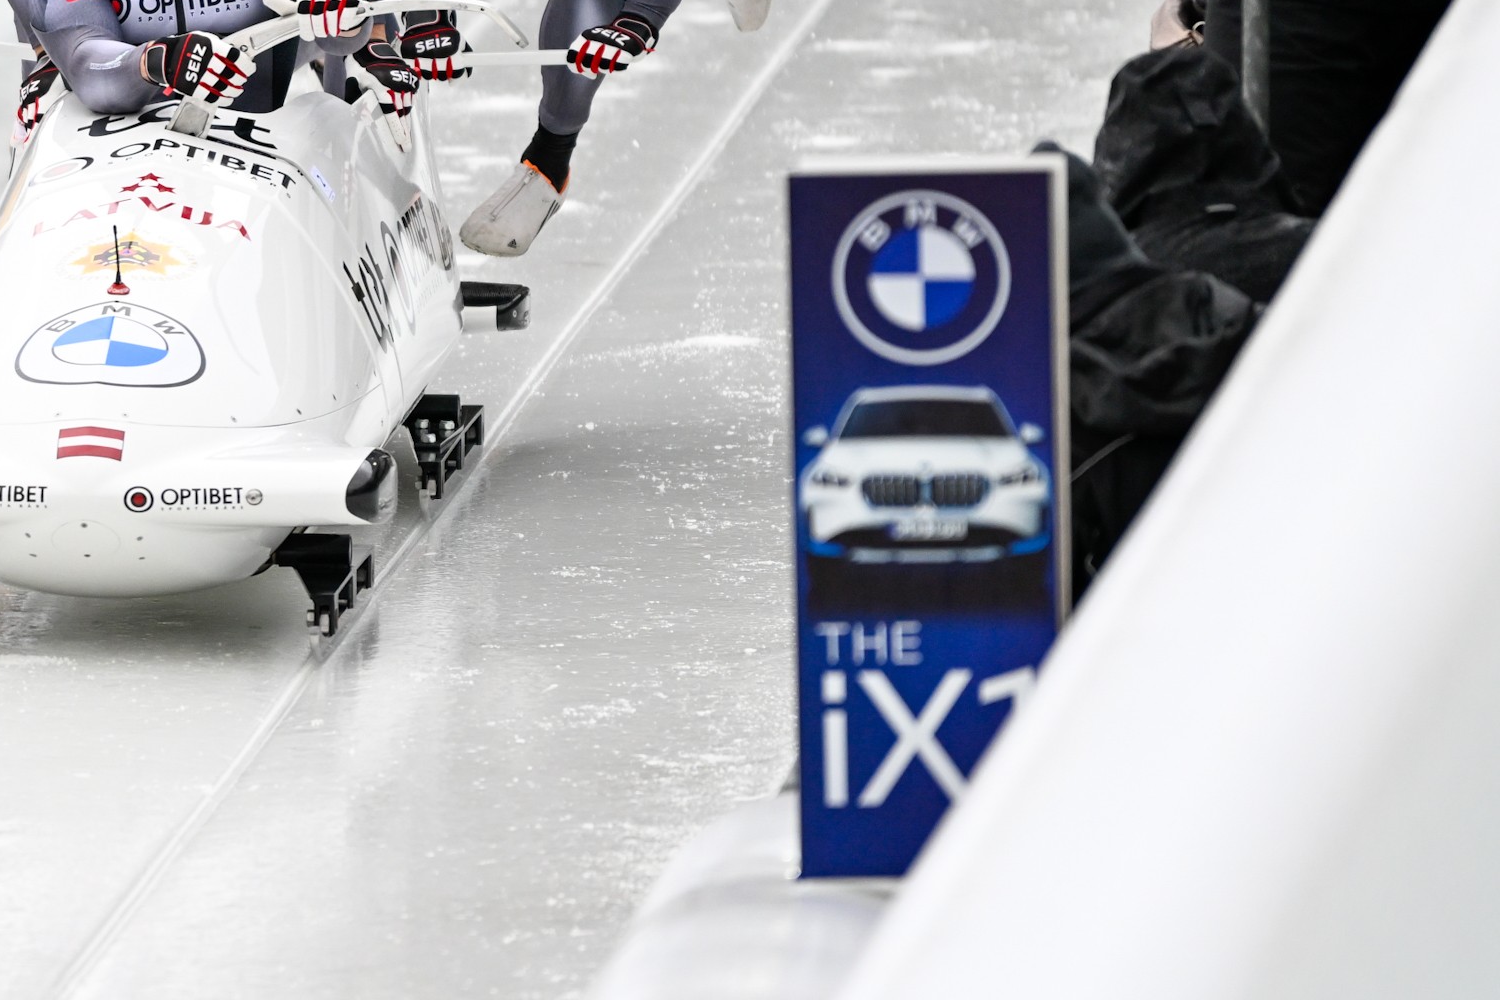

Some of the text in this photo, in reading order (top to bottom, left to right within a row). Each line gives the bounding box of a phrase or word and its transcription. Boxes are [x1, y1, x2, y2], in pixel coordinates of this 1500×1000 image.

[414, 33, 452, 53] SEIZ
[591, 26, 631, 46] SEIZ
[185, 43, 208, 83] SEIZ
[389, 68, 419, 88] SEIZ
[110, 138, 296, 190] OPTIBET
[32, 196, 252, 242] LATVIJA
[858, 198, 987, 252] BMW
[45, 304, 186, 336] BMW
[160, 487, 243, 506] OPTIBET
[814, 619, 924, 667] THE
